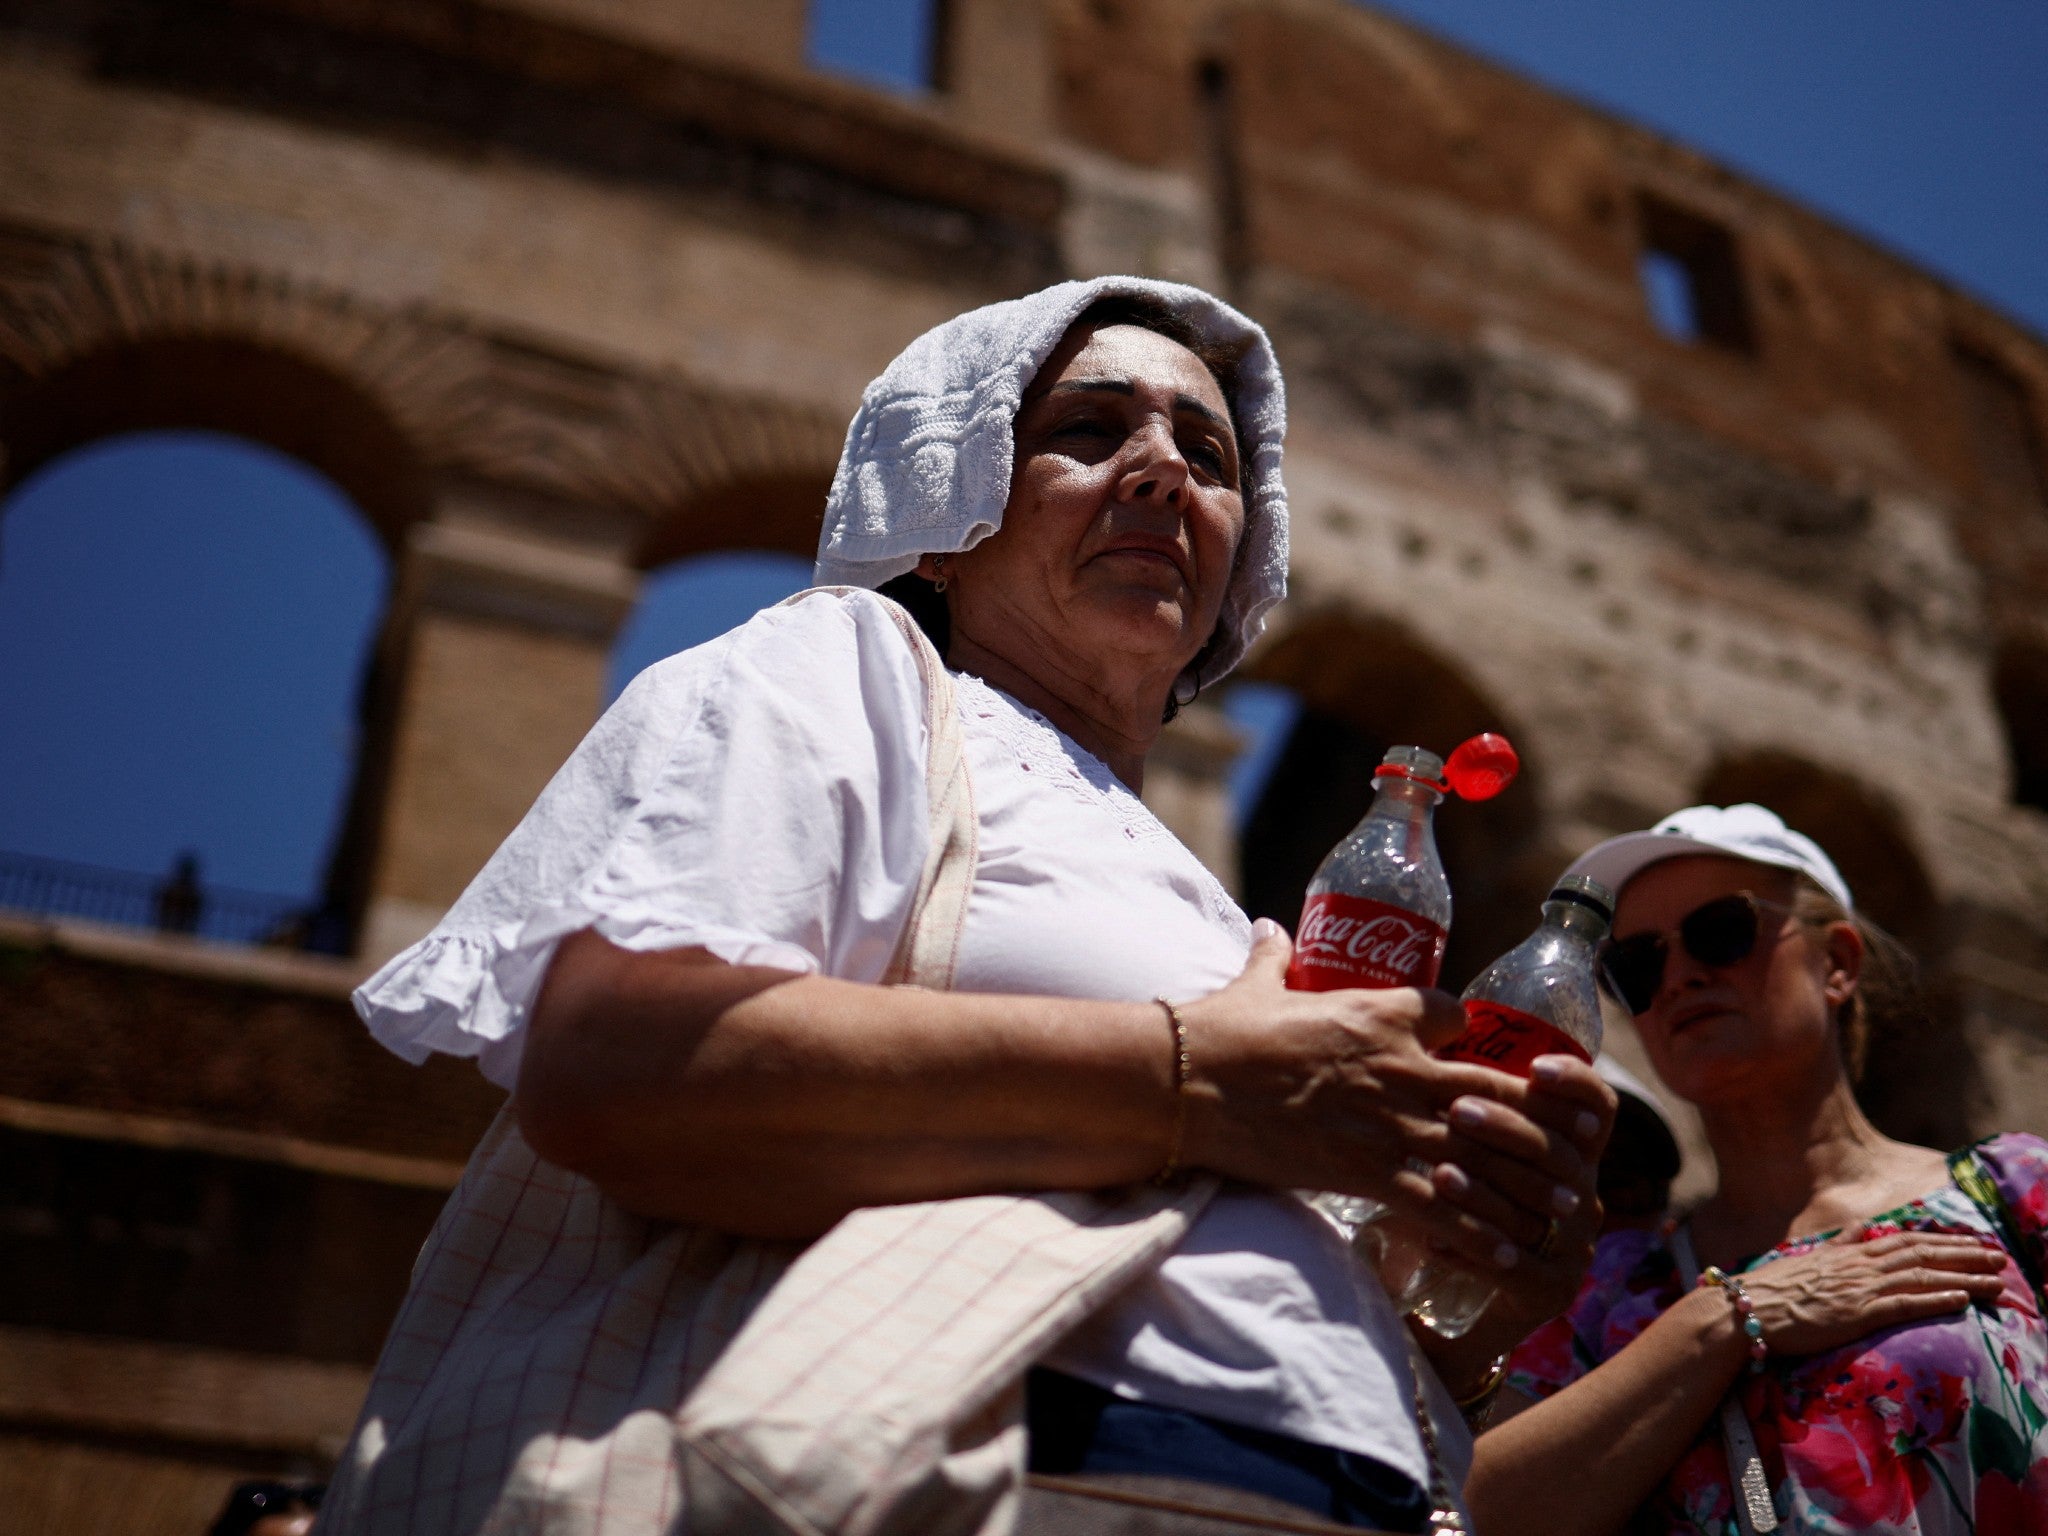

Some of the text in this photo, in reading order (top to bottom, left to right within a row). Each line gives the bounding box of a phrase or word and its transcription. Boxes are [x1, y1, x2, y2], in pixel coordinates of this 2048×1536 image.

[1295, 901, 1431, 974] Coca-Cola
[1302, 955, 1399, 984] ORIGINAL TASTE
